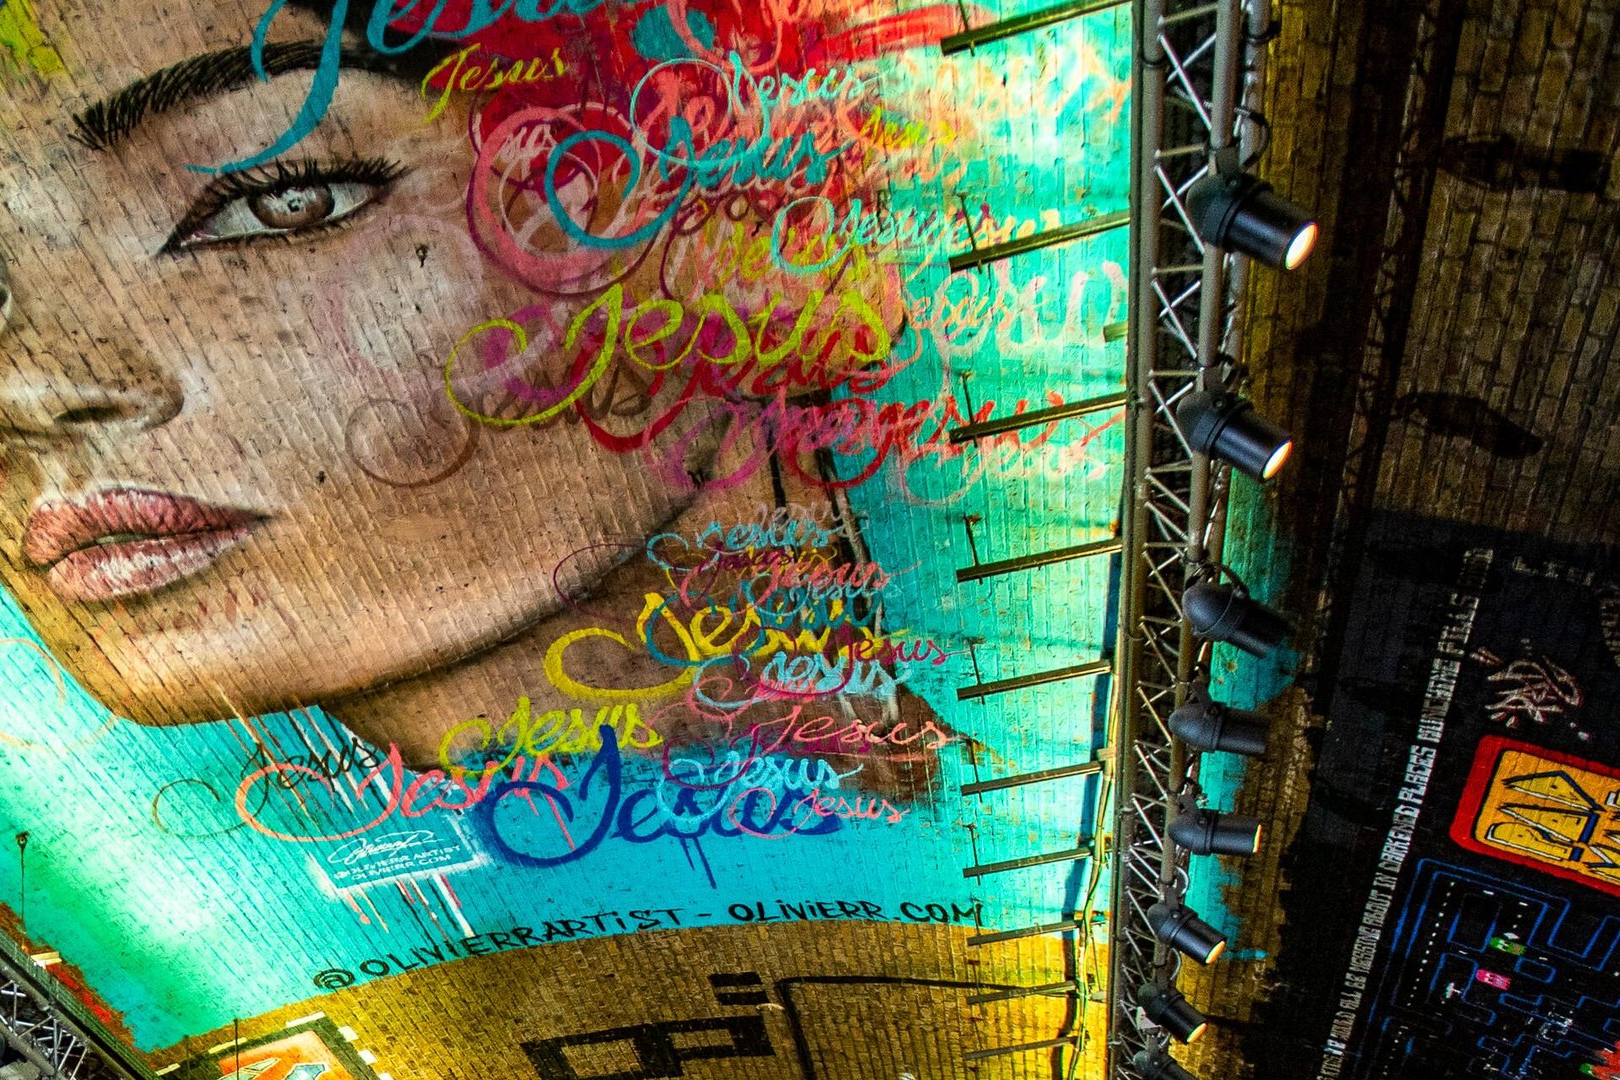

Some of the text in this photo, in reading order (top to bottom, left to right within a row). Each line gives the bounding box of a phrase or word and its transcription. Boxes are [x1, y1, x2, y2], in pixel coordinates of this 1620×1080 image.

[445, 283, 890, 427] Jesus
[439, 696, 664, 777] Jesus
[1395, 742, 1438, 806] PLACES
[1376, 802, 1420, 874] DARKENED
[1371, 871, 1398, 892] IN
[1360, 888, 1393, 929] ABOUT
[1345, 923, 1383, 975] MESSING
[1336, 986, 1363, 1012] ALL
[1342, 970, 1368, 991] BE
